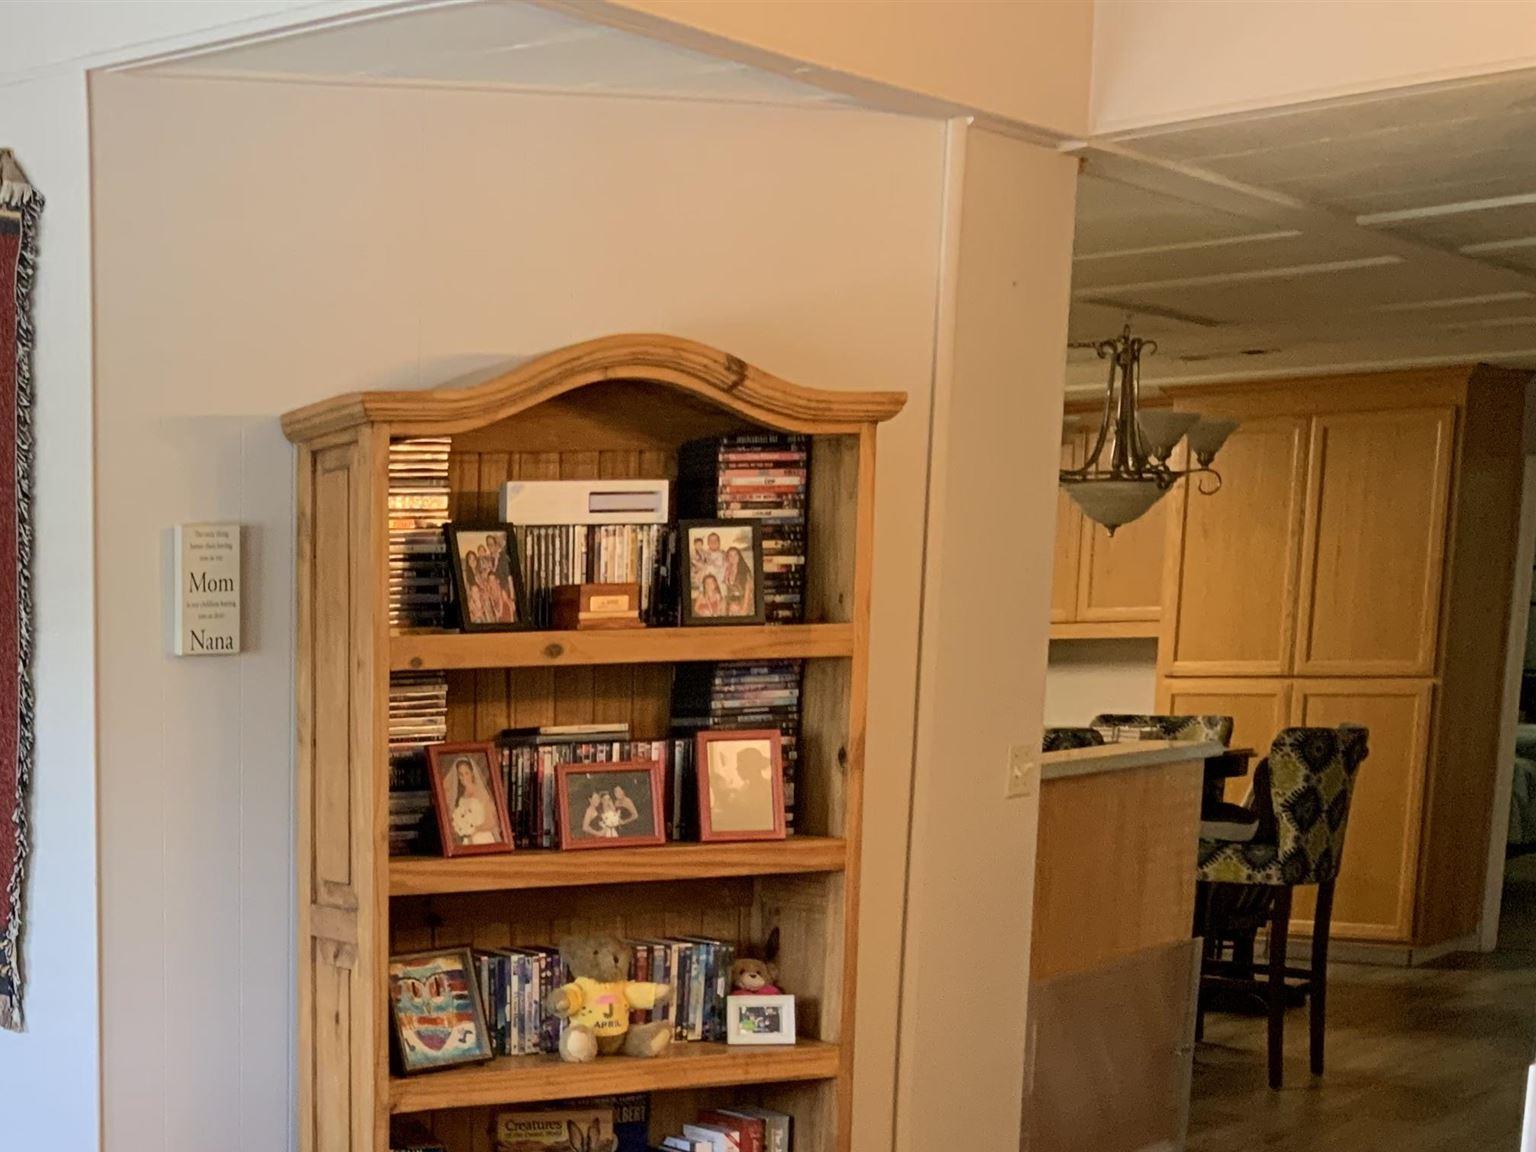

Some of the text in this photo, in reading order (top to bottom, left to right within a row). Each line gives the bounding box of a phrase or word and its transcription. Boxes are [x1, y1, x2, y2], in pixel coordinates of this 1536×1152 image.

[189, 571, 234, 594] Mom
[189, 628, 234, 652] Nana
[603, 1002, 614, 1019] J
[593, 1020, 622, 1029] APRIL
[504, 1118, 563, 1132] Creatures
